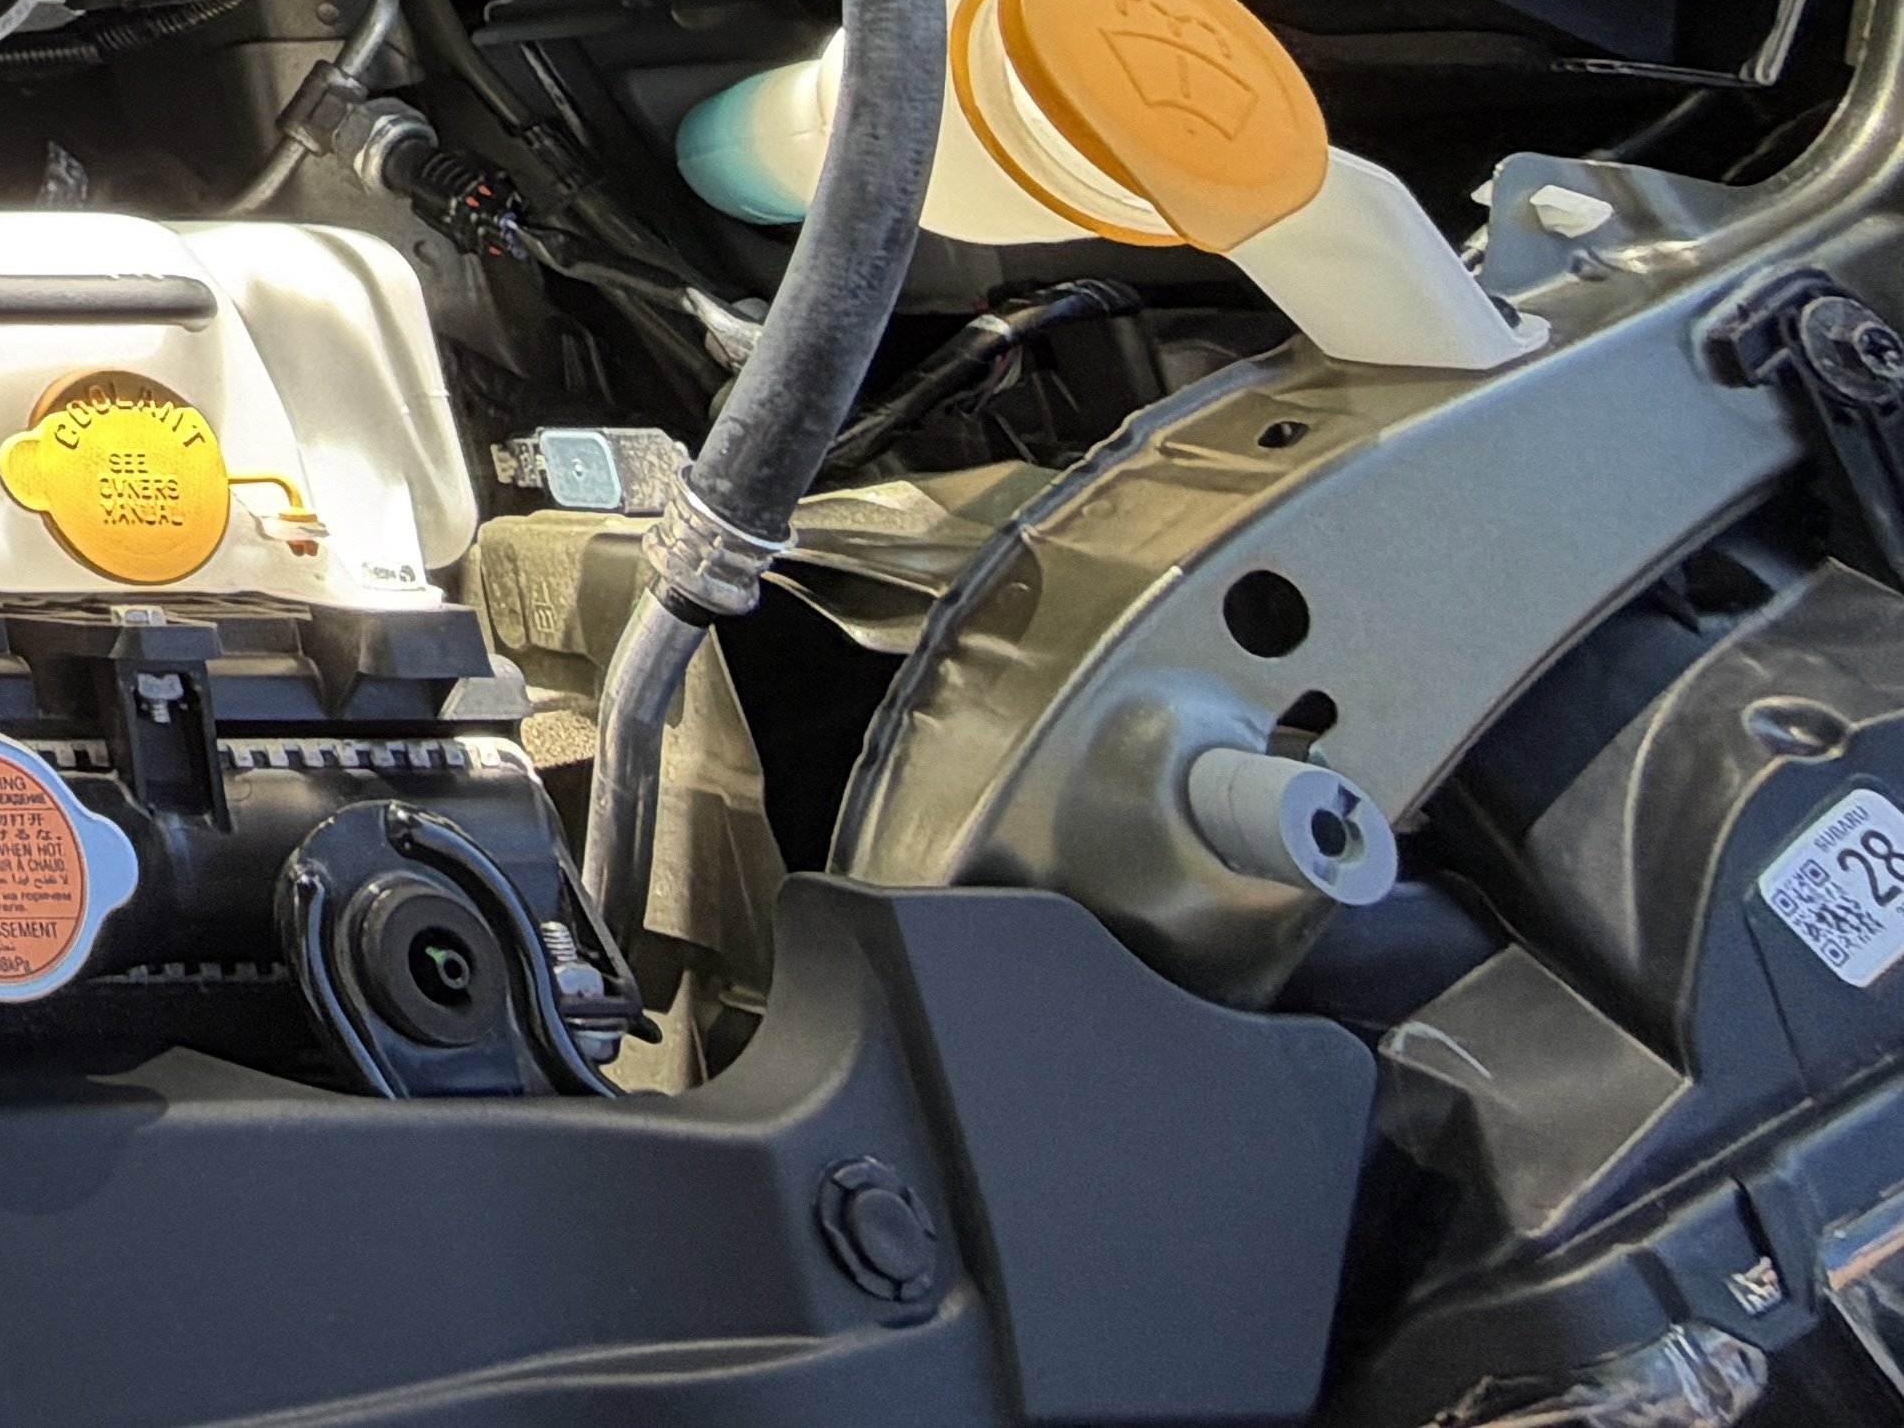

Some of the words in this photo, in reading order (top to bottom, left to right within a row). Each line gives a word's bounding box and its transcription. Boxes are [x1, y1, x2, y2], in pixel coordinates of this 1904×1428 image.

[53, 380, 205, 450] COOLANT
[108, 452, 148, 474] SEE
[101, 502, 183, 526] MANUAL
[1814, 805, 1869, 852] SUBARU
